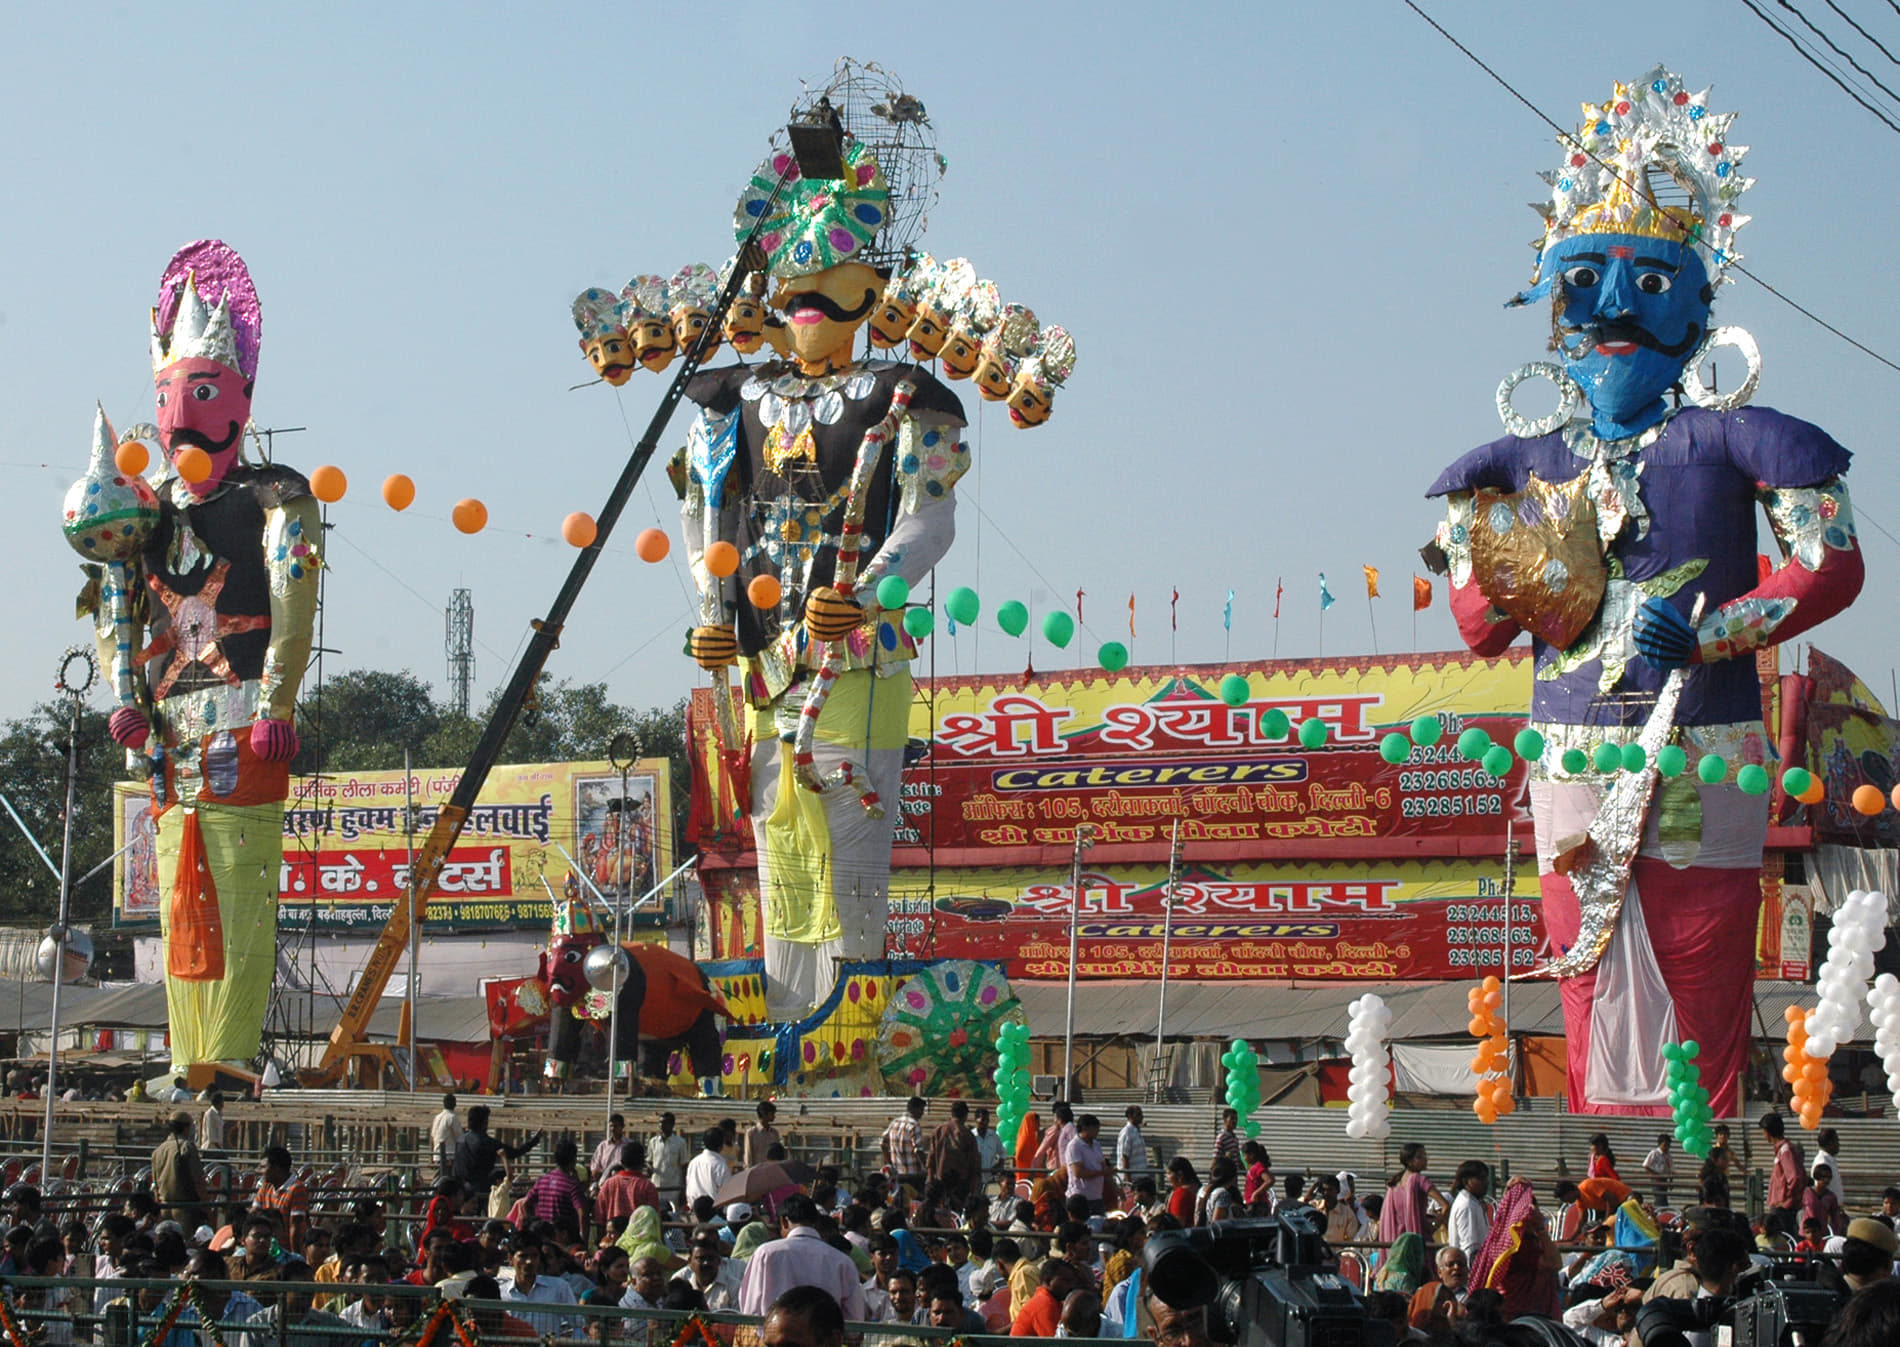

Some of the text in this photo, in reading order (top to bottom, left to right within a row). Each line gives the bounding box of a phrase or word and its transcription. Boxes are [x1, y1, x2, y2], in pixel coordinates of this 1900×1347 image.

[934, 693, 1384, 754] श्री श्याम
[1437, 711, 1464, 734] Ph:
[995, 762, 1303, 789] Caterers
[342, 778, 377, 798] लीला
[381, 776, 421, 795] कमेटी
[1040, 797, 1089, 820] 105,
[1255, 783, 1306, 815] चौक,
[1308, 782, 1392, 810] दिल्ली-6
[1402, 795, 1501, 817] 23285152
[980, 824, 1029, 845] श्री
[1161, 818, 1260, 841] लीला
[1264, 815, 1378, 839] कमेटी
[1017, 872, 1403, 914] श्री श्याम
[1477, 876, 1505, 896] Ph:
[1076, 923, 1336, 938] Caterers
[1089, 945, 1135, 961] 105,
[1448, 949, 1535, 967] 2328552
